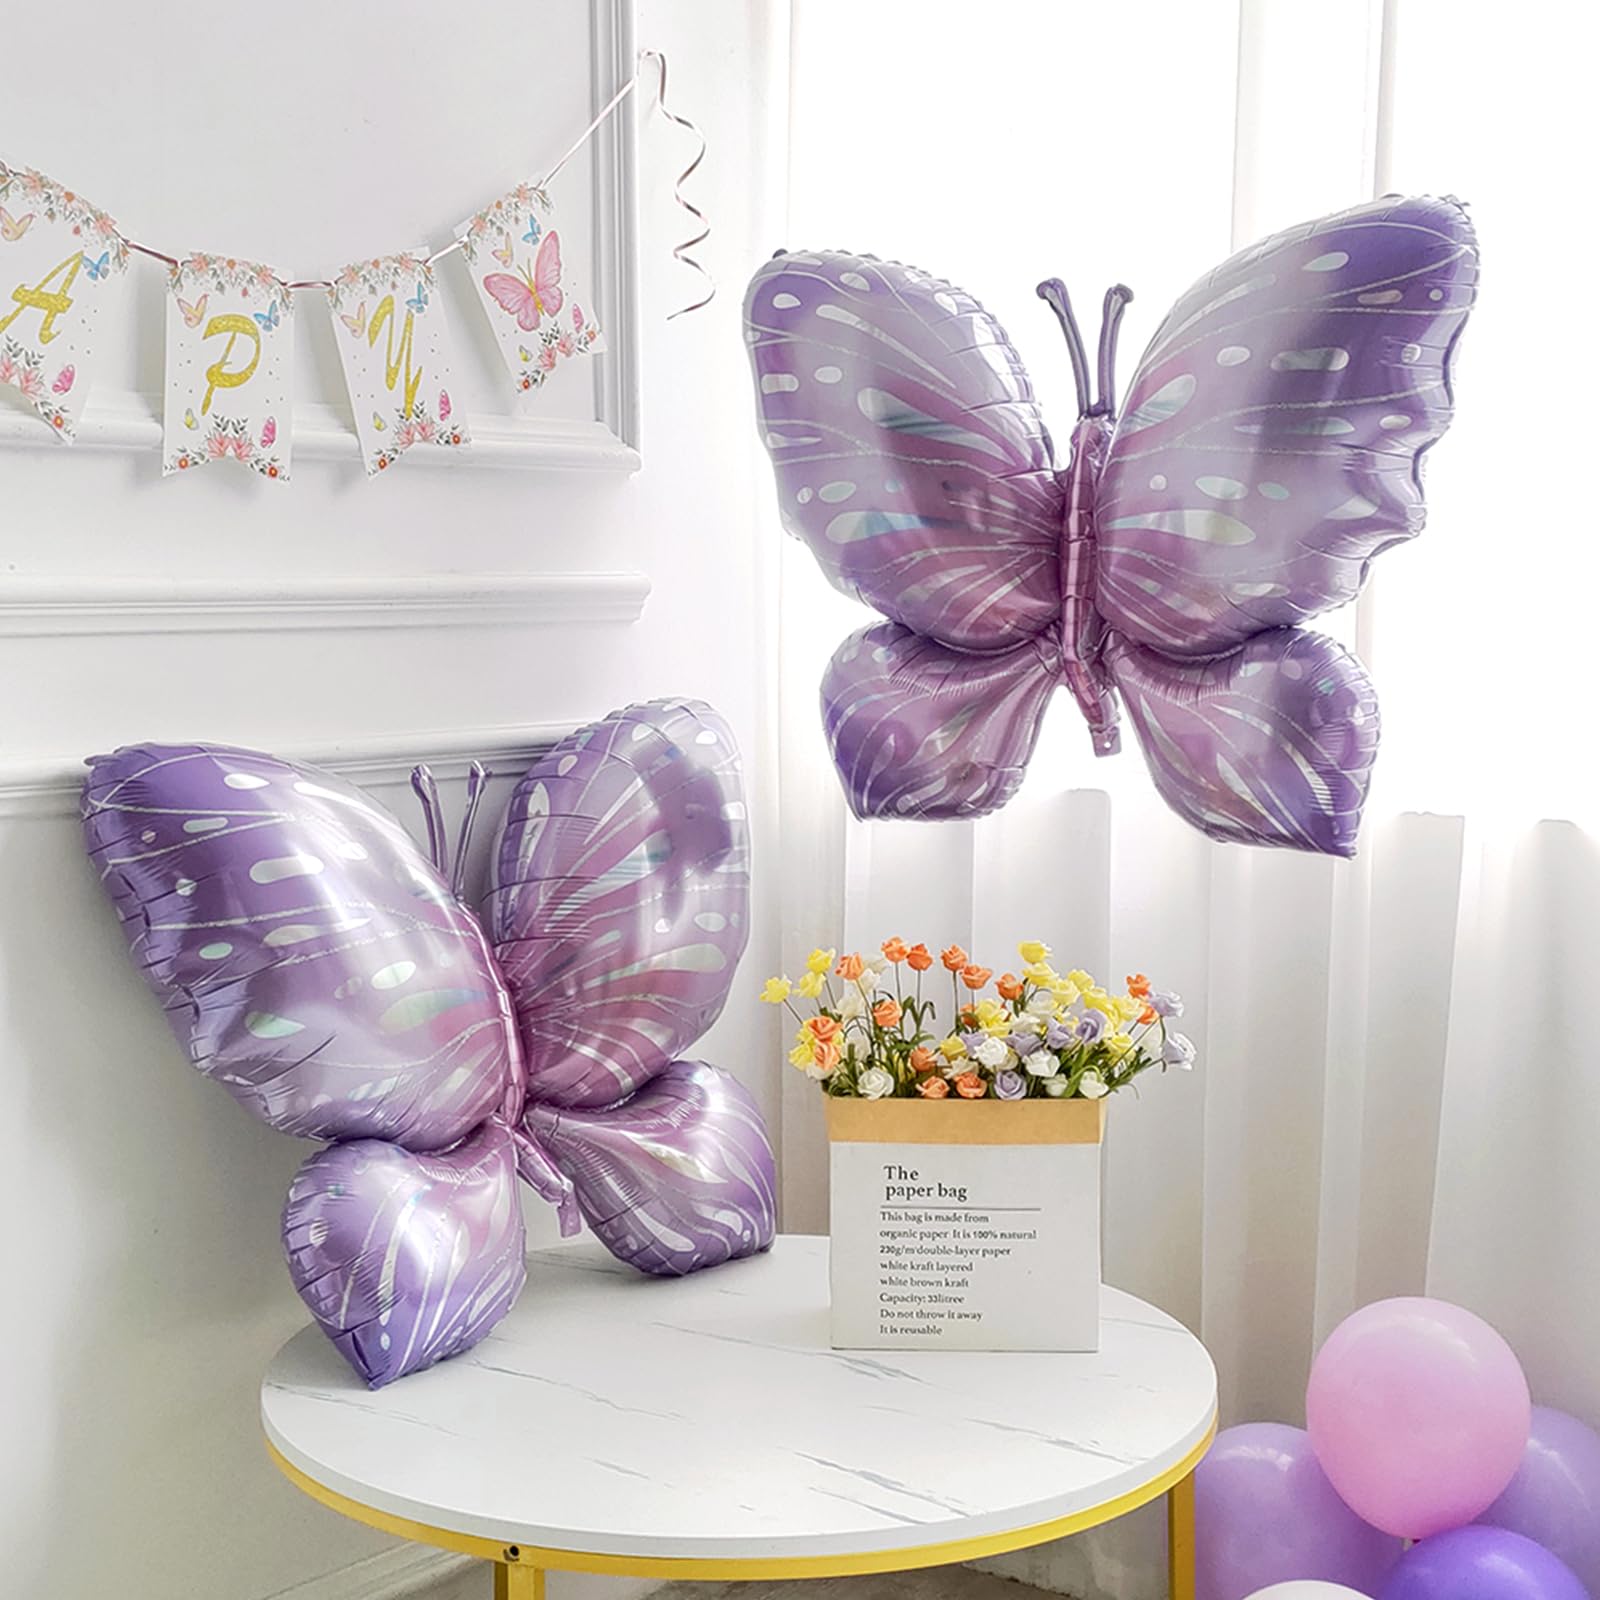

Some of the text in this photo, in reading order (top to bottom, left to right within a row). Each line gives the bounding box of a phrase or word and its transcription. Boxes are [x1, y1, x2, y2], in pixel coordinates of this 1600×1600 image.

[0, 250, 83, 345] A
[202, 313, 261, 415] P
[883, 1165, 919, 1181] The
[885, 1183, 968, 1202] paper bag
[880, 1211, 989, 1224] This bag is made from
[880, 1229, 1037, 1241] organic paper It is 100% natural
[982, 1248, 1011, 1258] paper
[880, 1261, 973, 1274] white kraft layered
[880, 1277, 968, 1288] white brown kraft
[880, 1309, 982, 1322] Do not throw it away
[880, 1325, 942, 1335] It is reusable
